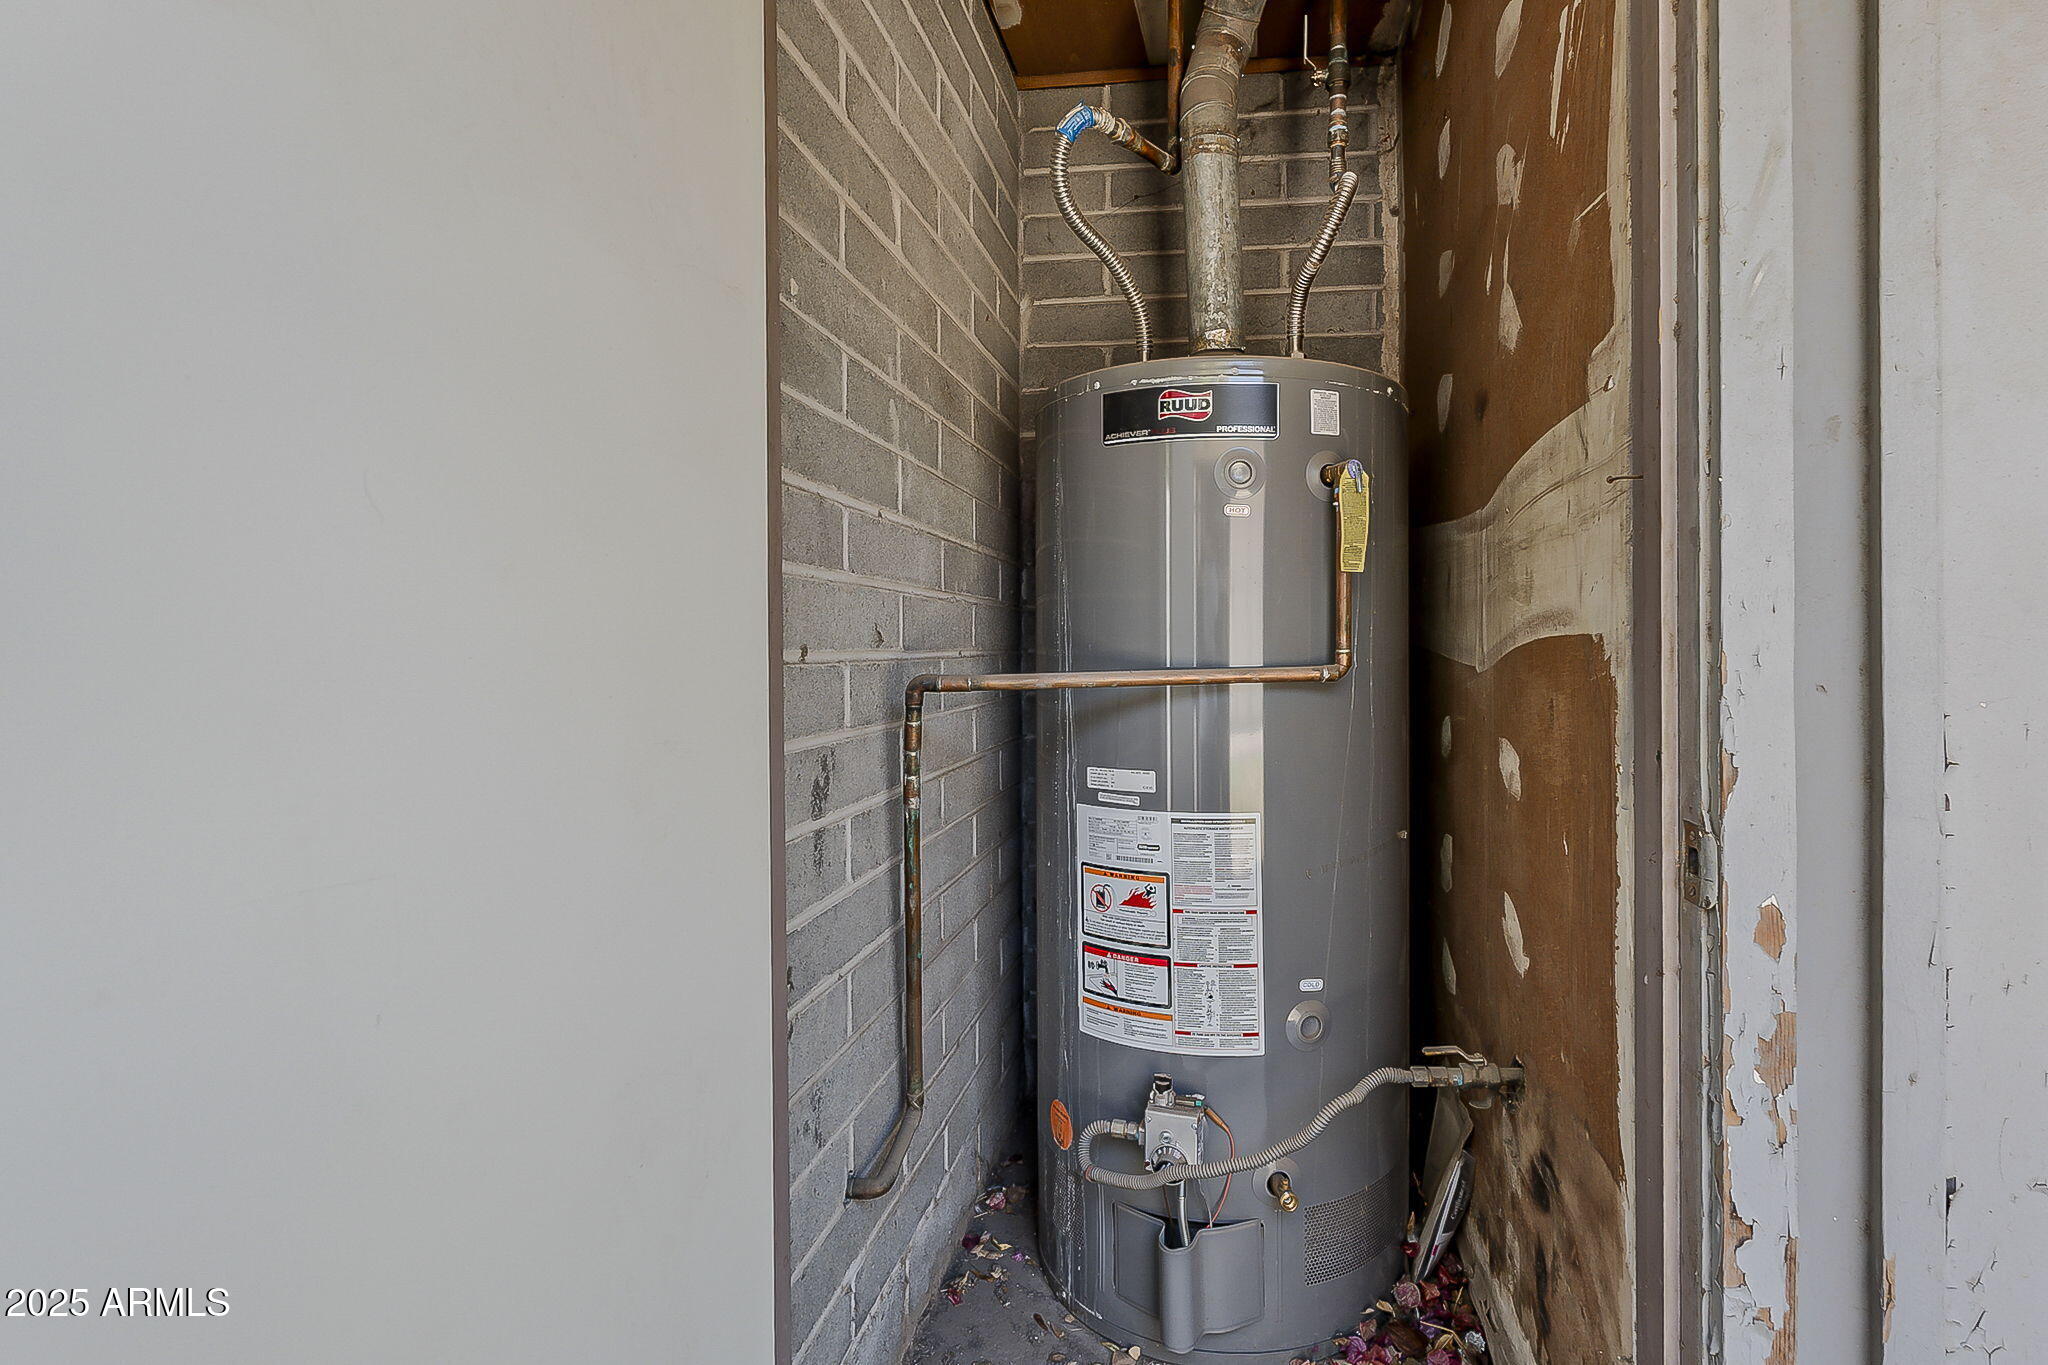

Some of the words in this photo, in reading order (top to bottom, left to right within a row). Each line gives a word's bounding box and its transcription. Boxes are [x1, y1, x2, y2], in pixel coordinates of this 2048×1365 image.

[1160, 399, 1211, 413] RUUD
[1216, 425, 1275, 433] PROFESSIONAL
[1110, 872, 1140, 881] WARNING
[1112, 953, 1140, 963] DANGER
[1114, 1007, 1142, 1017] WARNING
